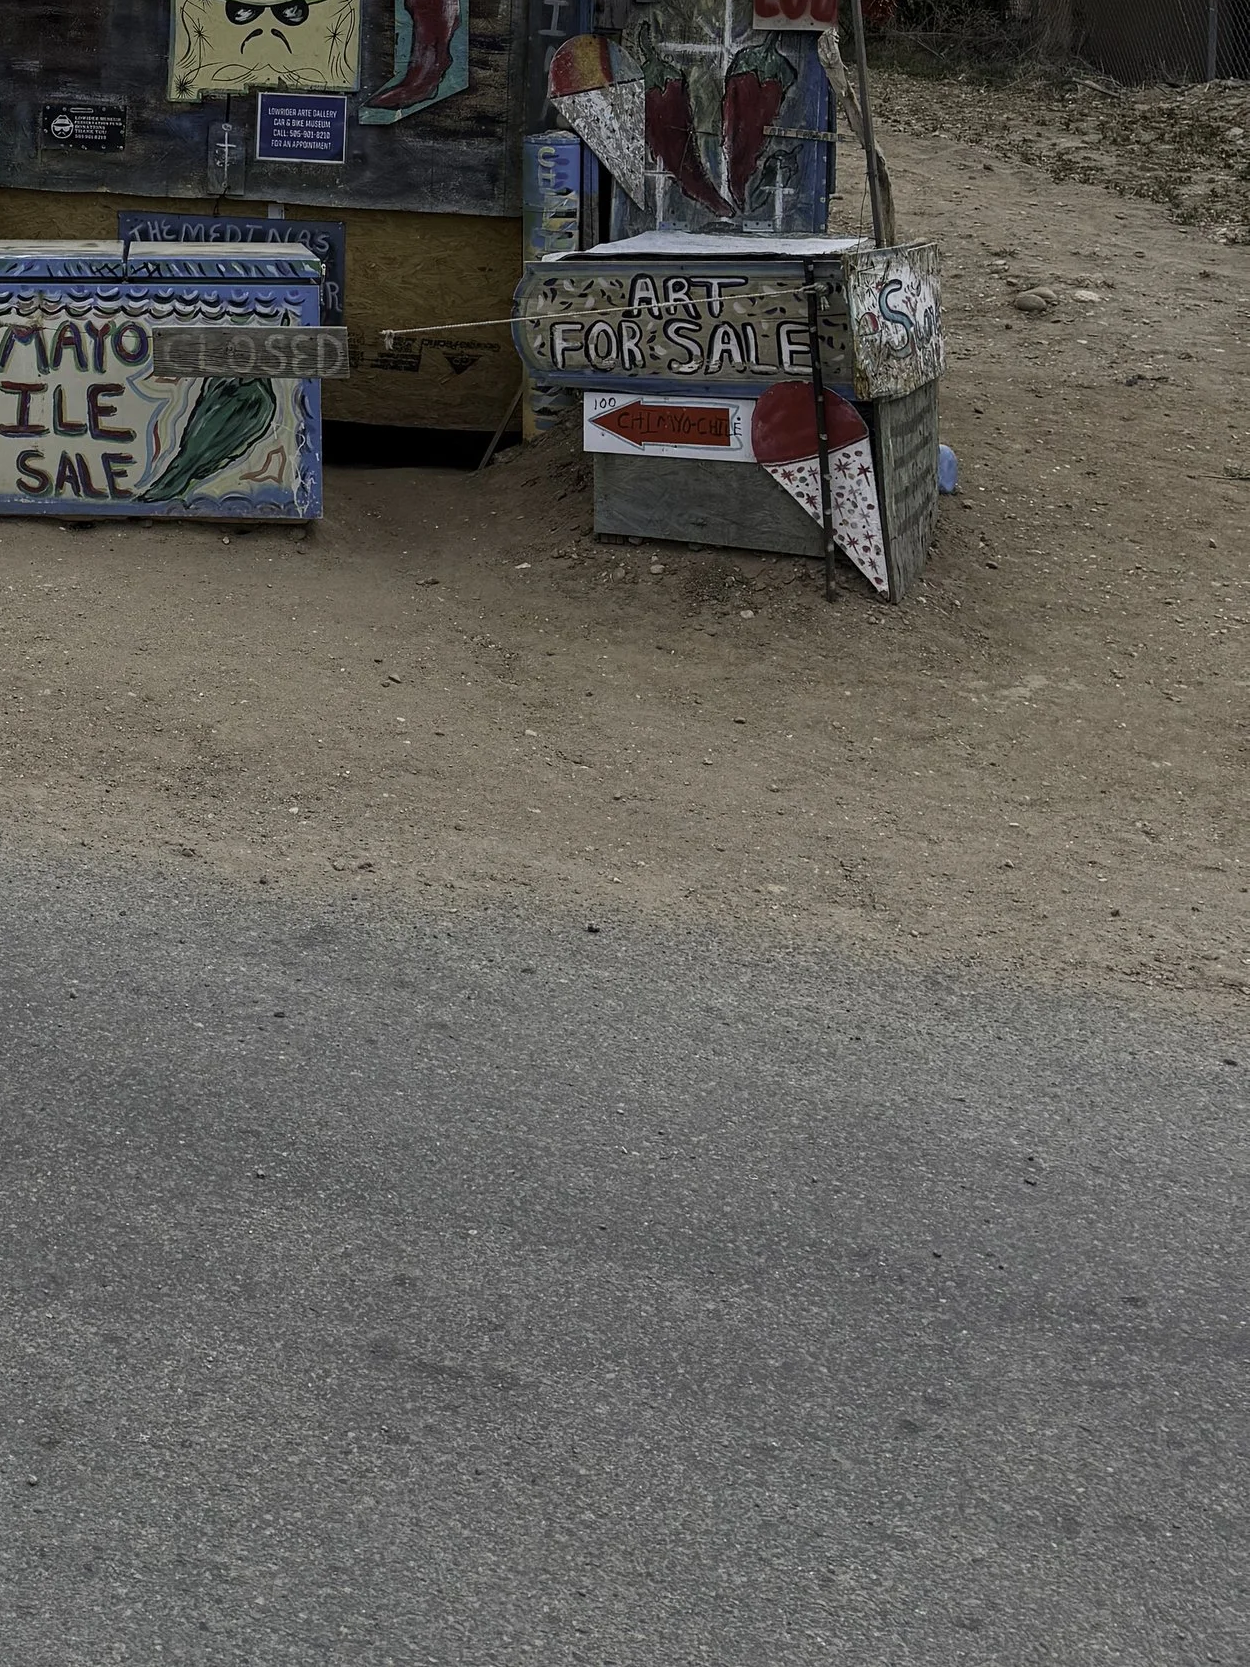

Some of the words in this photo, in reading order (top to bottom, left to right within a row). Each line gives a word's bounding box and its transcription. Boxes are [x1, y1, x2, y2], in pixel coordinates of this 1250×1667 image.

[268, 107, 296, 116] LOWRIDER
[297, 109, 312, 117] ARTE
[313, 110, 337, 119] GALLERY
[273, 118, 285, 126] CAR
[291, 119, 304, 127] BIKE
[273, 129, 289, 137] CALL:
[271, 139, 282, 147] FOR
[283, 140, 291, 148] AN
[292, 141, 331, 150] APPOINTMENT
[622, 273, 748, 320] ART
[550, 319, 645, 373] FOR
[663, 318, 814, 375] SALE
[164, 334, 344, 377] CLOSED
[594, 397, 617, 411] 100
[16, 450, 139, 499] SALE
